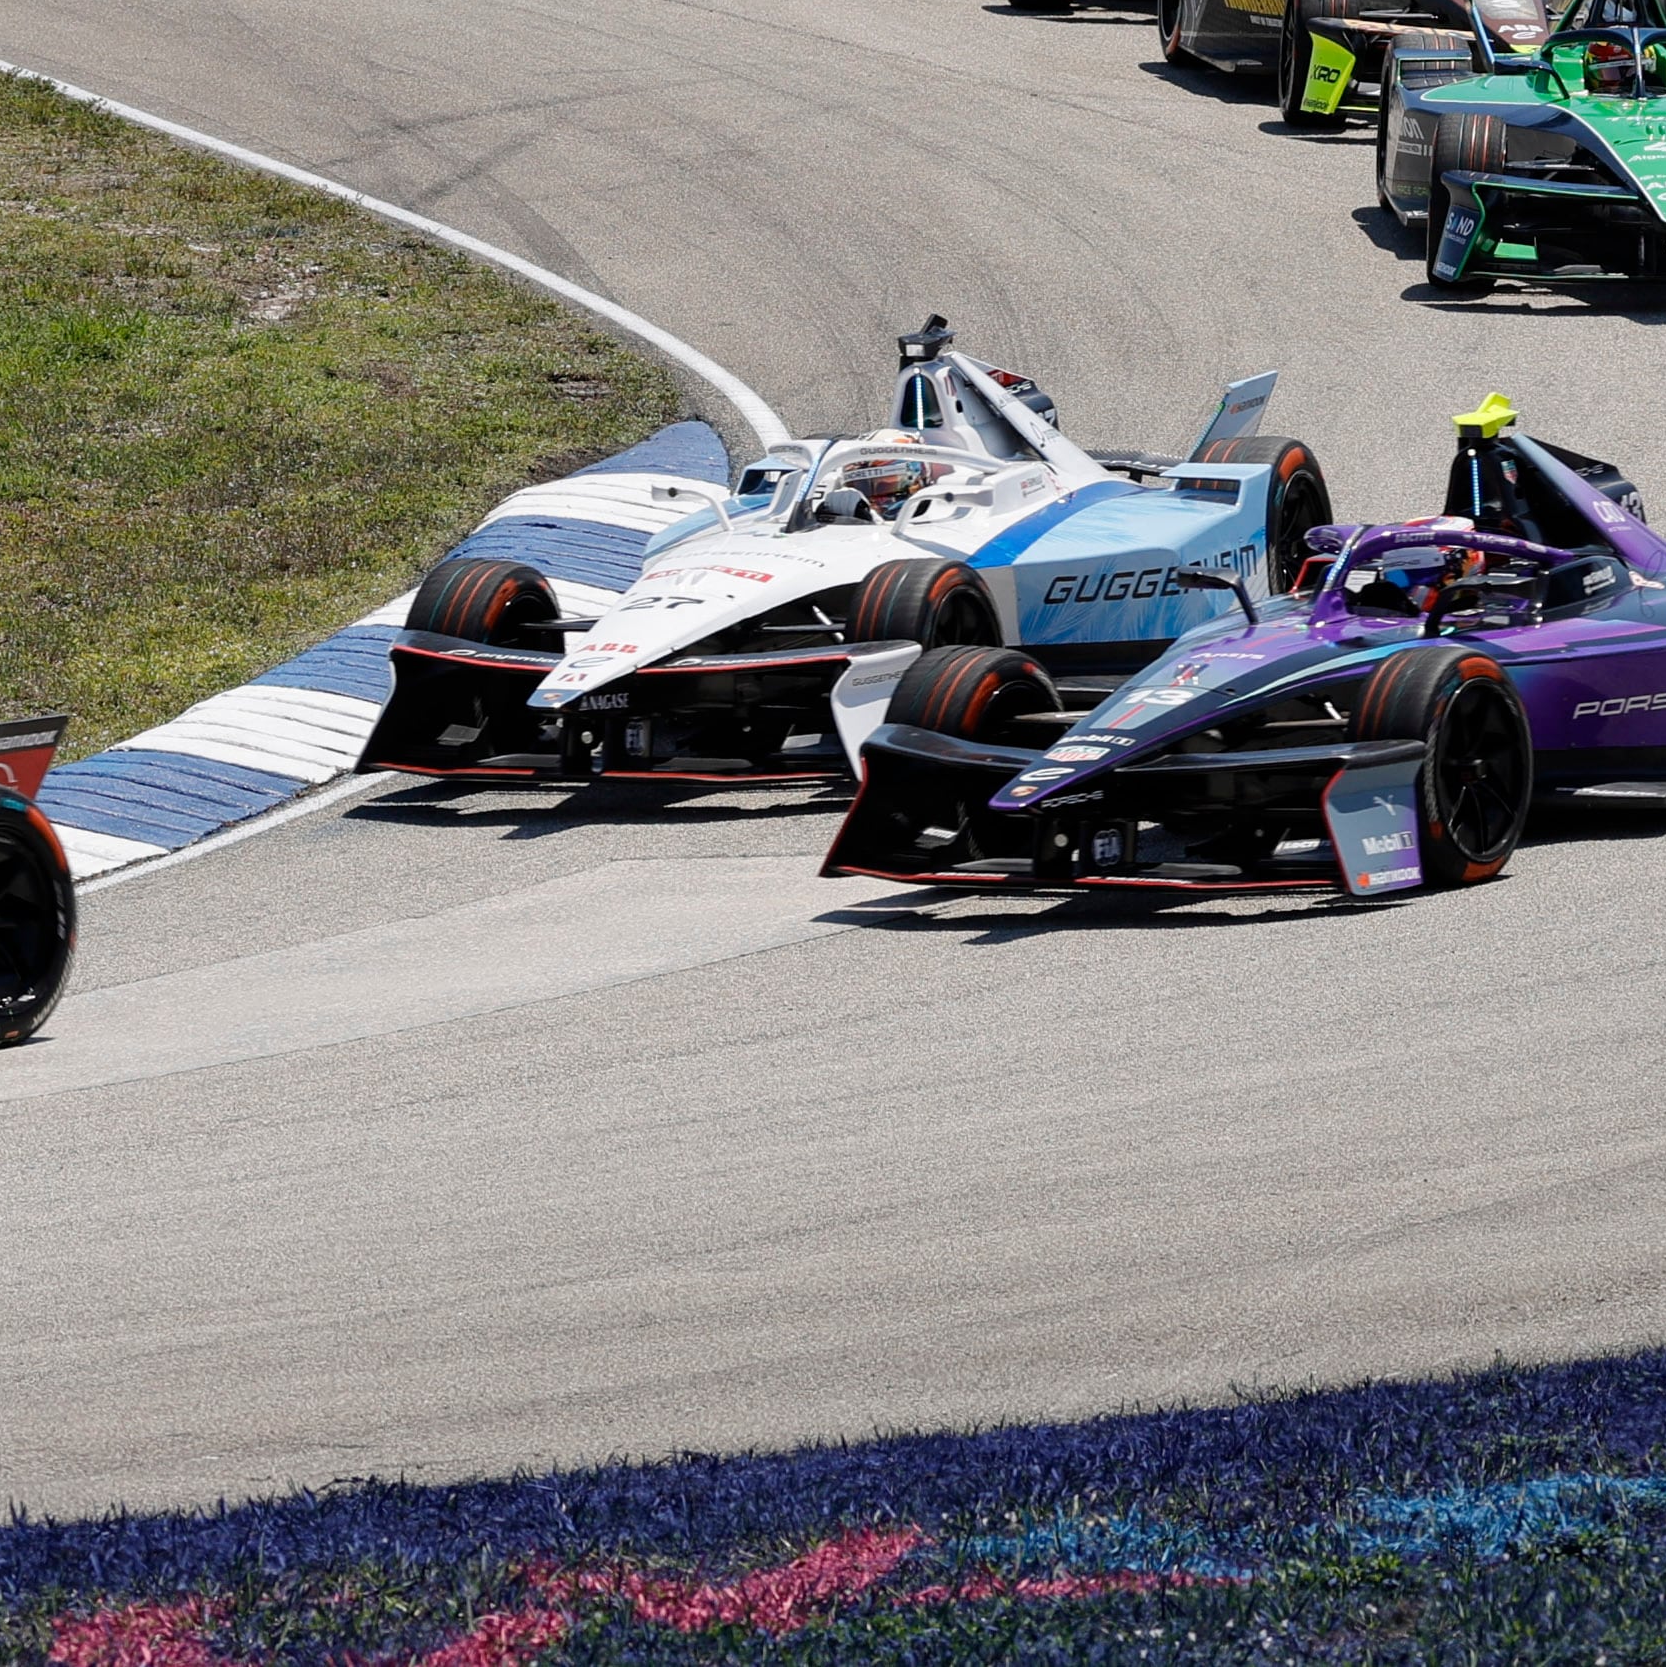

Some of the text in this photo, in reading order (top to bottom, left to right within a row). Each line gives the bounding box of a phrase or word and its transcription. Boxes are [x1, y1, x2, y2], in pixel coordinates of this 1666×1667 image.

[620, 595, 705, 611] 27
[576, 643, 639, 654] ABB
[1124, 688, 1197, 706] 13
[1040, 789, 1106, 809] PORSCHE
